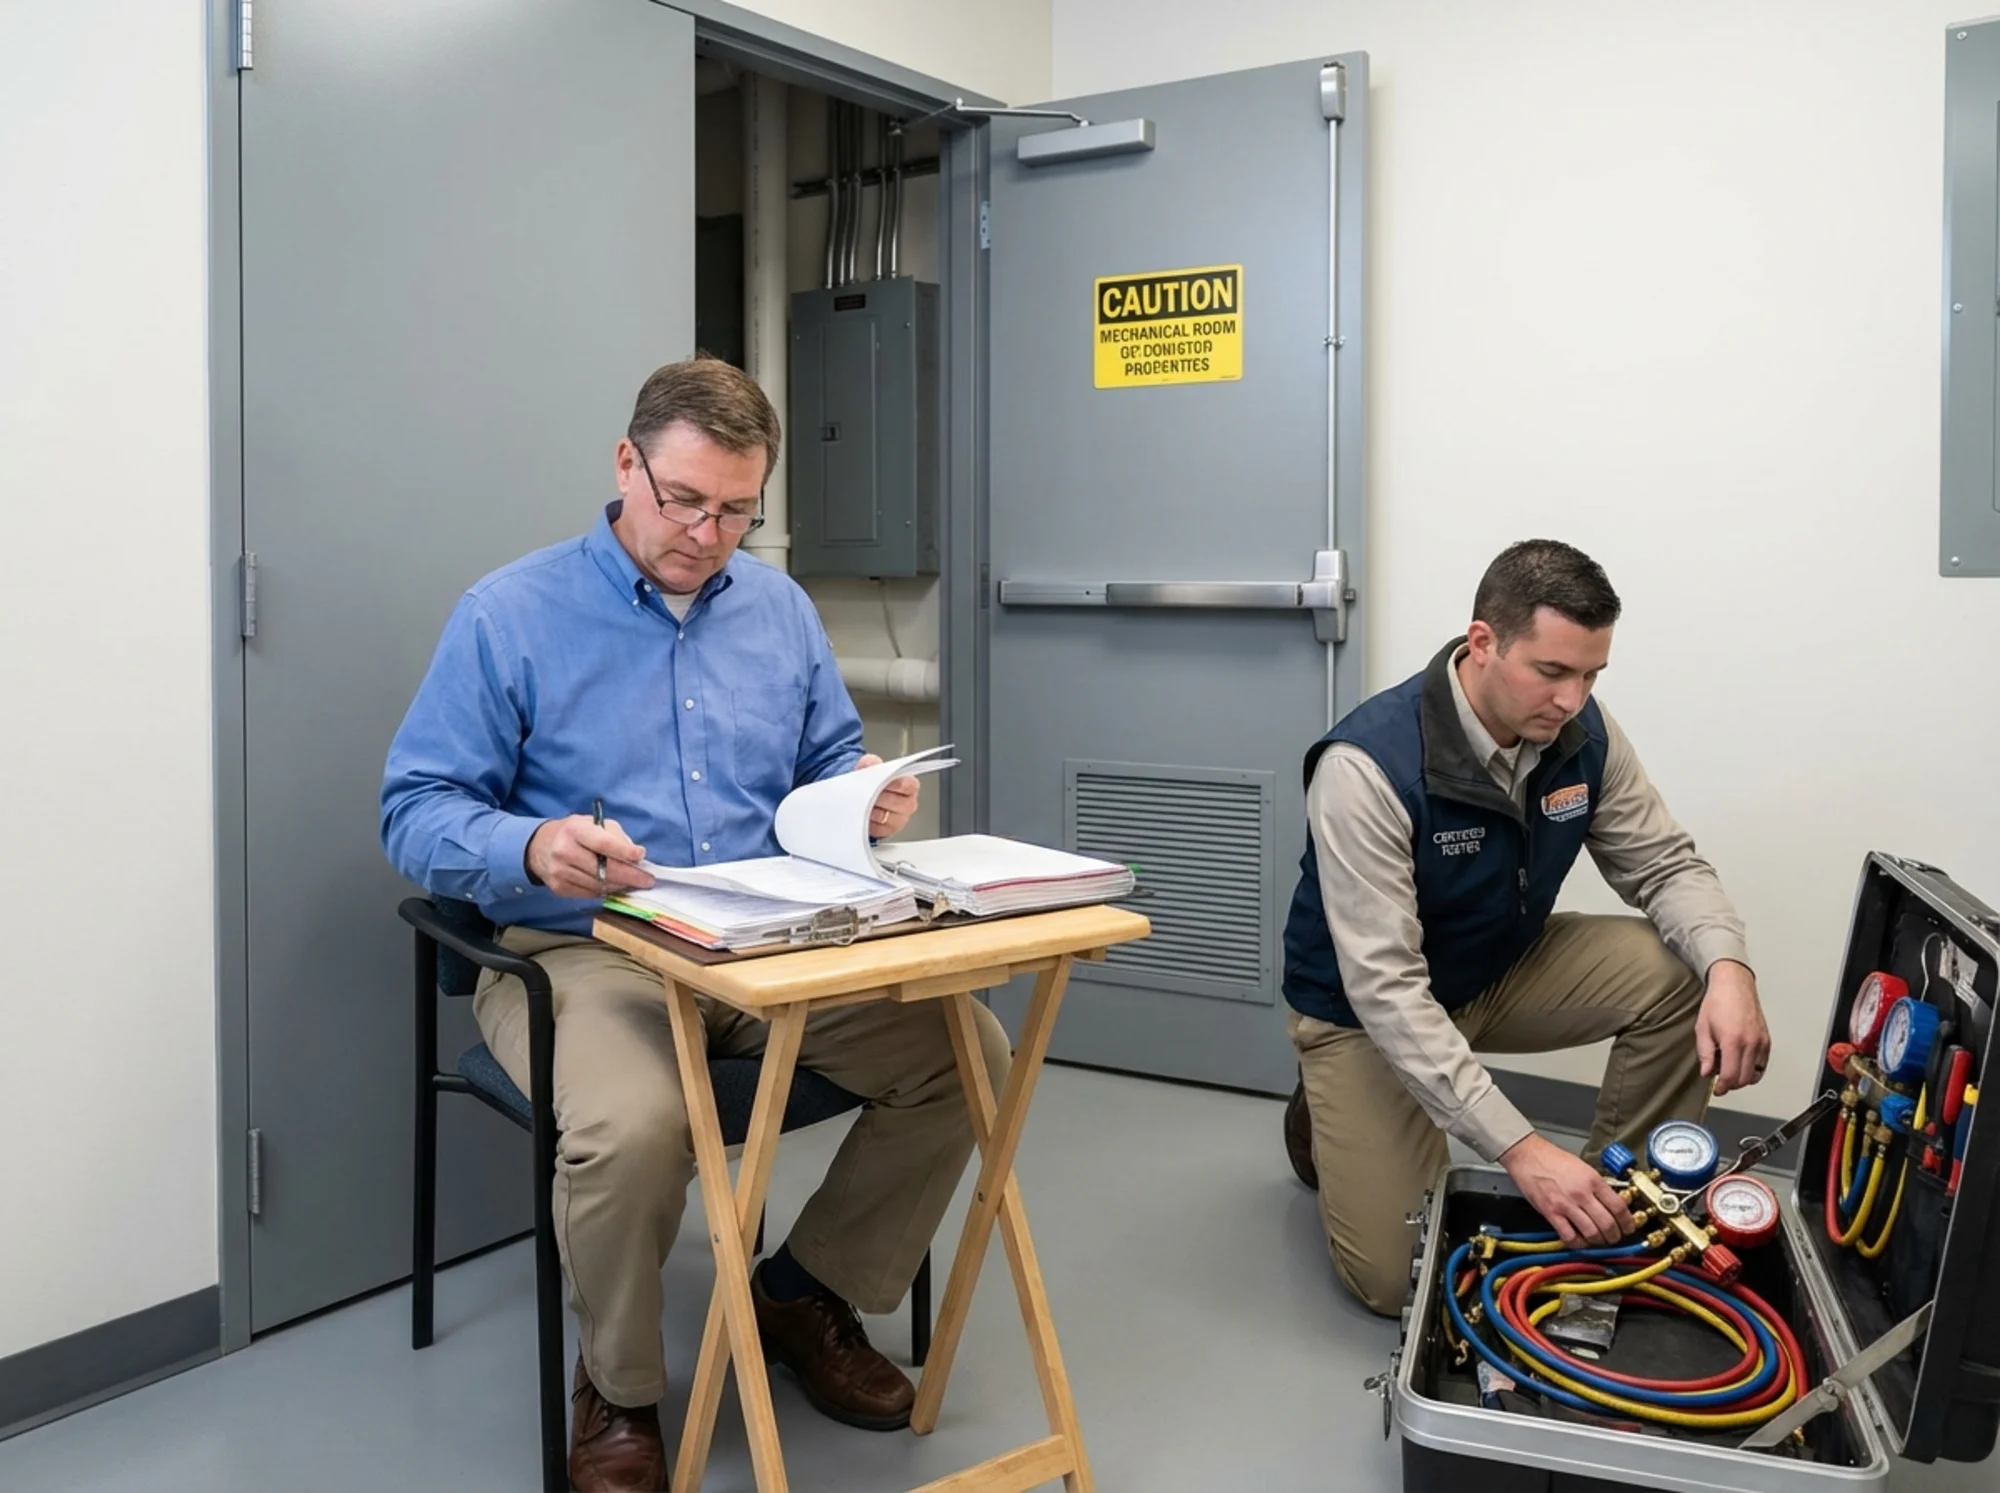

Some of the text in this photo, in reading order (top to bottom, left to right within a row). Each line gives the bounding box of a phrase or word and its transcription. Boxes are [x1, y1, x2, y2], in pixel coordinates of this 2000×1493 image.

[1102, 277, 1233, 318] CAUTION
[1100, 320, 1236, 344] MECHANICAL ROOM
